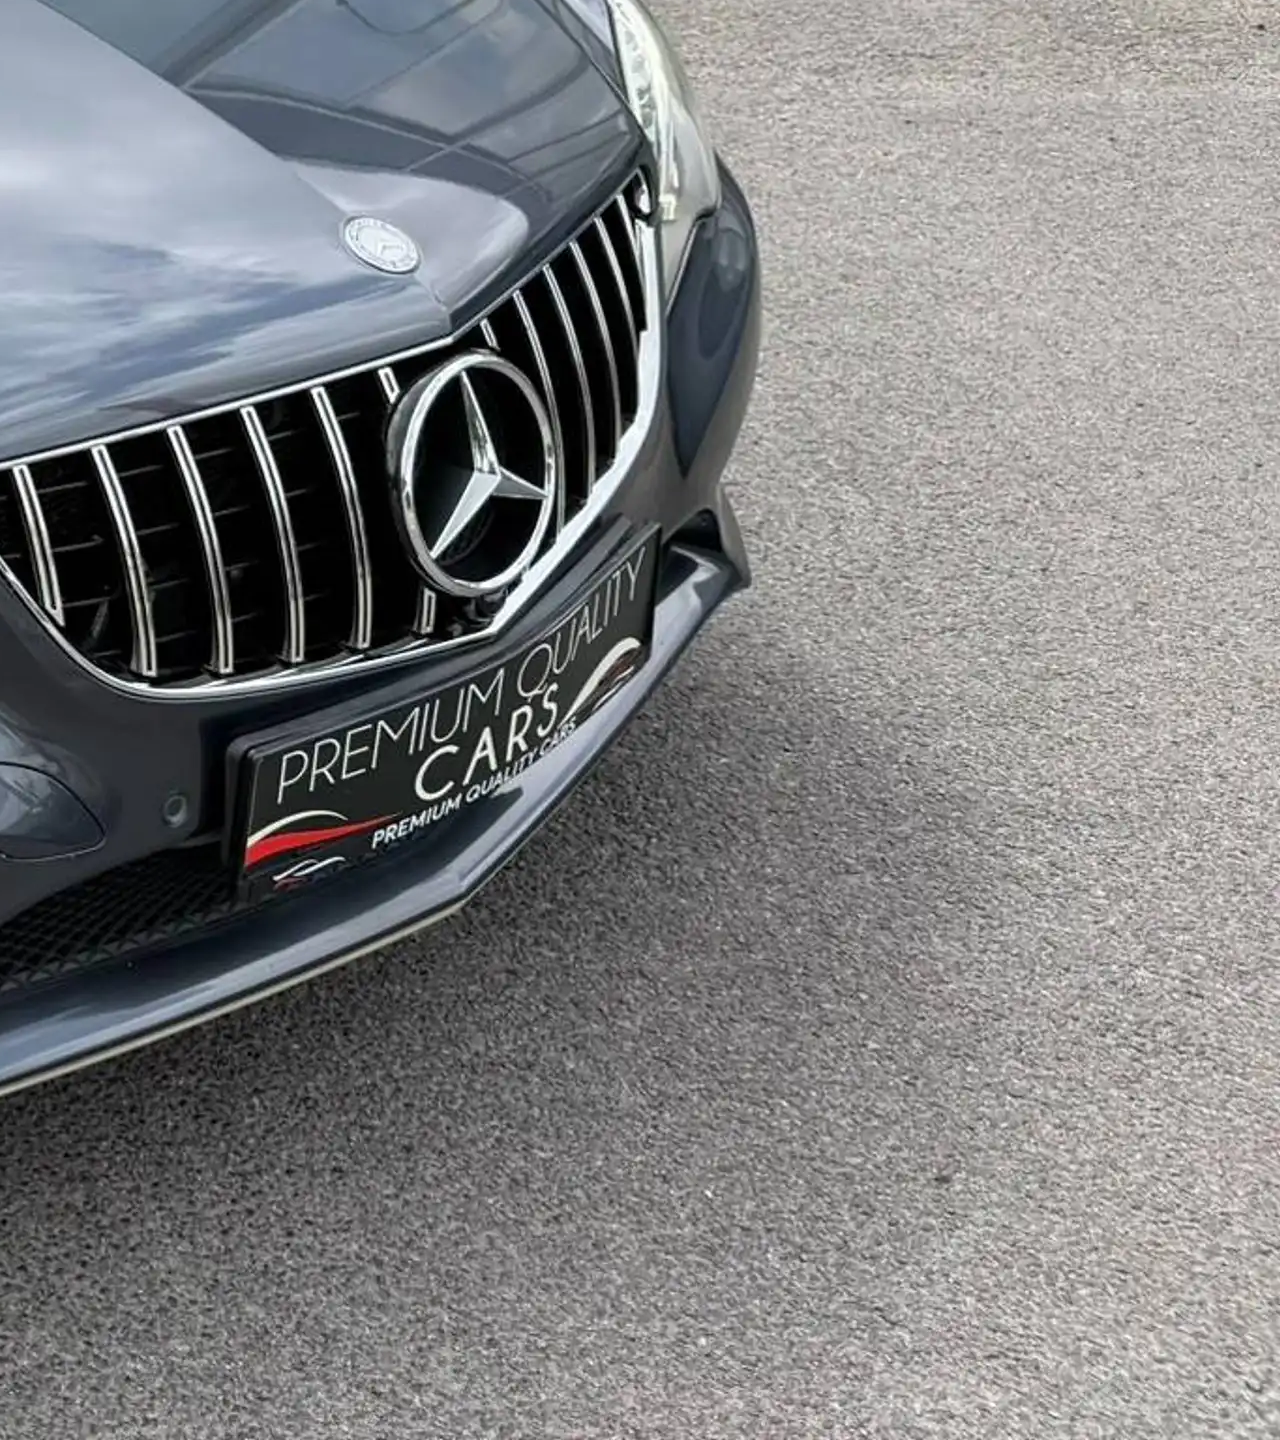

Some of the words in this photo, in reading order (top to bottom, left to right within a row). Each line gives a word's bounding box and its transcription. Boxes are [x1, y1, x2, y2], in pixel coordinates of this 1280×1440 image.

[277, 668, 505, 805] PREMIUM
[517, 546, 647, 704] QUALITY
[414, 682, 560, 801] CARS
[372, 793, 462, 850] PREMIUM
[466, 746, 539, 803] QUALITY
[539, 716, 577, 755] CARS
